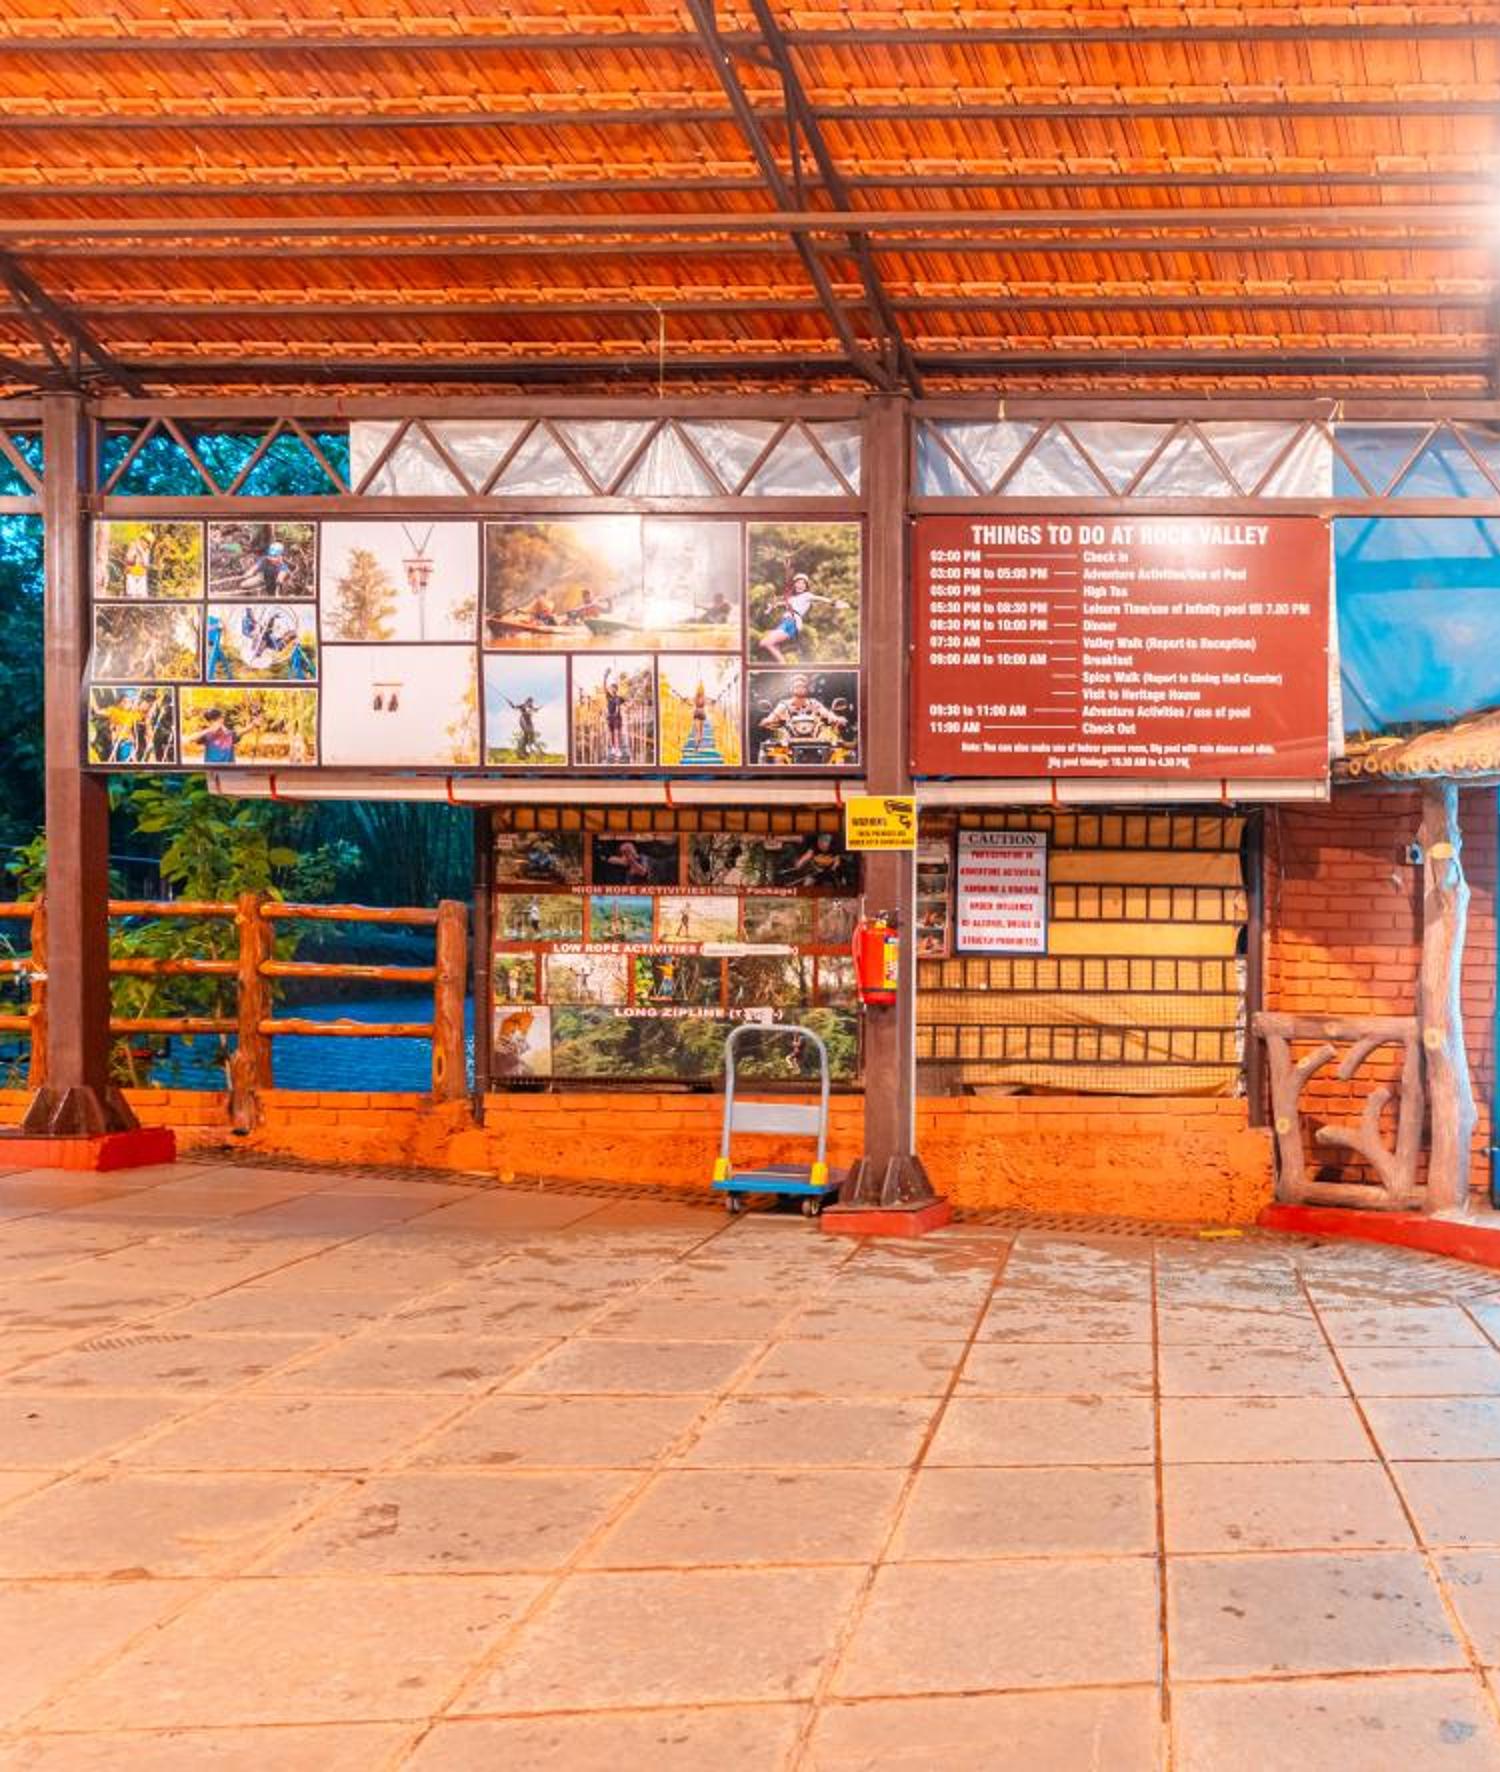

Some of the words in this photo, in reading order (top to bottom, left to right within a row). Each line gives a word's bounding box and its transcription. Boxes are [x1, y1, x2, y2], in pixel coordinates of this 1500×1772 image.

[971, 525, 1041, 545] THINGS
[1047, 525, 1072, 545] TO
[1079, 525, 1105, 545] DO
[1111, 525, 1134, 545] AT
[1141, 525, 1195, 545] ROCK
[1200, 525, 1269, 545] VALLEY
[963, 550, 981, 562] PM
[1083, 551, 1115, 563] Check
[963, 567, 981, 579] PM
[983, 567, 994, 579] to
[1030, 567, 1048, 579] PM
[1083, 569, 1135, 581] Adventure
[1210, 569, 1221, 581] of
[963, 585, 981, 596] PM
[1083, 586, 1107, 598] High
[1110, 586, 1128, 598] Tea
[963, 602, 981, 613] PM
[983, 602, 994, 613] to
[1030, 602, 1048, 613] PM
[1083, 603, 1120, 615] Leisure
[1172, 603, 1183, 615] of
[1224, 603, 1245, 617] pool
[1292, 603, 1310, 615] PM
[963, 619, 981, 631] PM
[983, 619, 994, 631] to
[997, 619, 1027, 631] 10:00
[1030, 619, 1048, 631] PM
[1083, 620, 1117, 631] Dinner
[963, 636, 981, 648] AM
[1083, 638, 1114, 650] Valley
[1117, 638, 1143, 649] Walk
[1145, 637, 1184, 651] (Report
[1186, 638, 1198, 649] to
[1200, 638, 1256, 651] Reception)
[963, 653, 981, 665] AM
[983, 653, 994, 665] to
[1029, 653, 1047, 665] AM
[1082, 655, 1133, 666] Breakfast
[1082, 672, 1111, 684] Spice
[1114, 672, 1140, 683] Walk
[1180, 673, 1189, 683] to
[1082, 689, 1106, 700] Visit
[1108, 689, 1119, 700] to
[1121, 689, 1166, 702] Heritage
[1168, 689, 1200, 700] House
[962, 704, 974, 716] to
[1008, 704, 1027, 716] AM
[1082, 706, 1134, 718] Adventure
[1137, 706, 1184, 718] Activities
[1194, 708, 1212, 718] use
[1215, 706, 1227, 718] of
[1228, 707, 1250, 720] pool
[963, 721, 981, 733] AM
[1082, 723, 1115, 734] Check
[1117, 723, 1136, 734] Out
[968, 833, 1037, 845] CAUTION
[606, 885, 637, 895] ROPE
[553, 943, 582, 953] LOW
[585, 943, 619, 953] ROPE
[624, 943, 697, 954] ACTIVITIES
[614, 1007, 657, 1017] LONG
